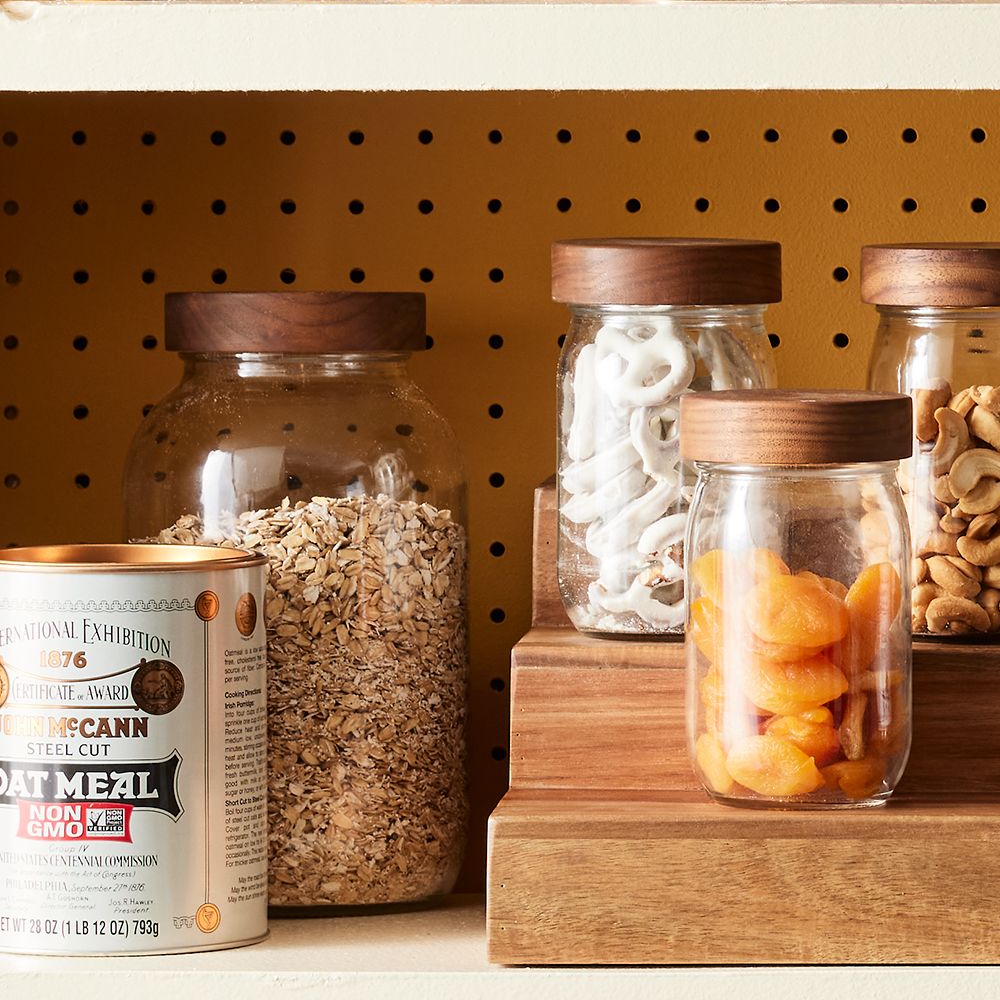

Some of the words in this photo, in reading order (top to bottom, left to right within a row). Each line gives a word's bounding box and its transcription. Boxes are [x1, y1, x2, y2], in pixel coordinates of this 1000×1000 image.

[0, 620, 79, 648] ERNATIONAL
[83, 618, 171, 658] EXHIBITION
[40, 650, 87, 669] 1876
[87, 685, 129, 701] AWARD
[0, 714, 45, 737] OHN
[26, 742, 73, 756] STEEL
[78, 743, 112, 757] CUT
[55, 770, 159, 800] MEAL
[30, 805, 81, 821] NON
[27, 821, 83, 838] GMO
[104, 854, 159, 868] COMMISSION
[0, 916, 10, 932] ET
[12, 917, 26, 932] WT
[30, 919, 41, 934] 28
[45, 919, 58, 935] OZ
[61, 920, 71, 938] (1
[76, 920, 89, 935] LB
[93, 920, 106, 935] 12
[110, 920, 129, 938] OZ)
[132, 919, 159, 938] 793g
